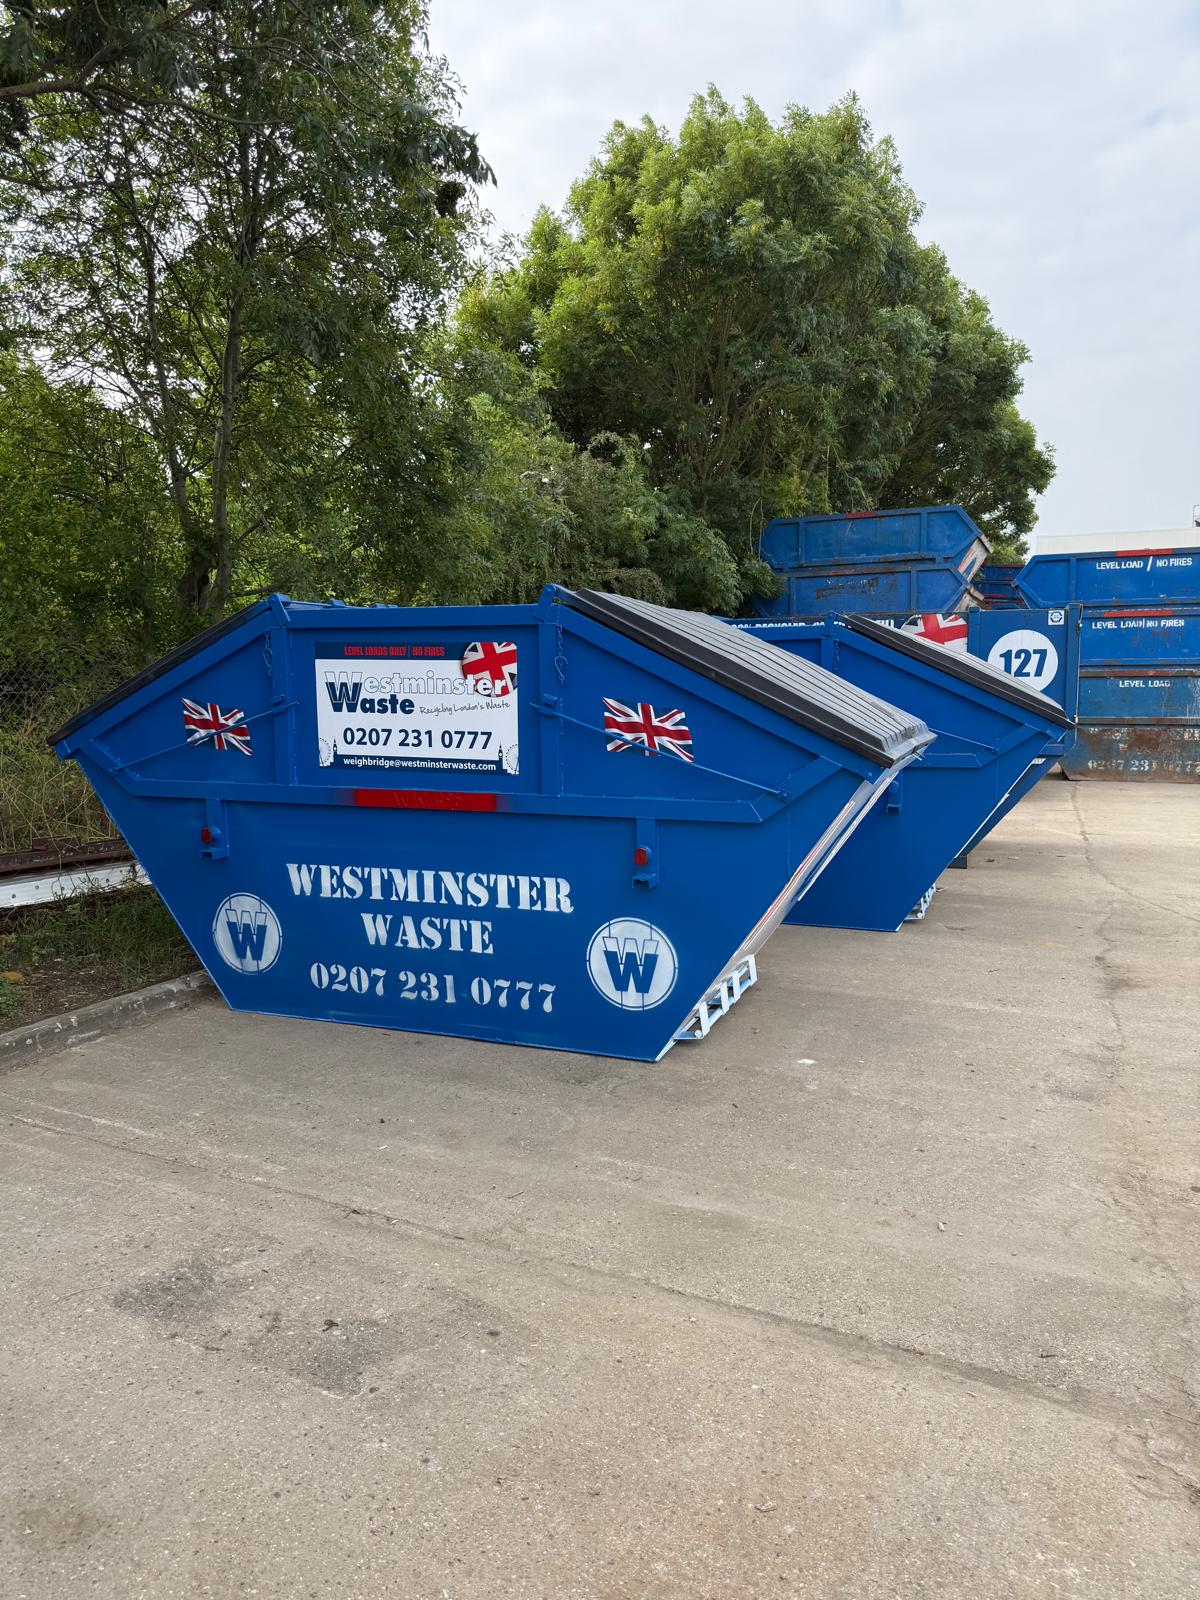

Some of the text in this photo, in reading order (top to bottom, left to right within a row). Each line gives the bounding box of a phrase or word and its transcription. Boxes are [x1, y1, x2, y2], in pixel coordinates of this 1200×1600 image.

[1096, 561, 1120, 570] LEVEL
[1121, 560, 1143, 569] LOAD
[1156, 559, 1168, 567] NO
[1169, 558, 1192, 566] FIRES
[1092, 620, 1117, 629] LEVEL
[1160, 619, 1185, 628] FIRES
[344, 646, 363, 656] LEVEL
[364, 646, 388, 656] LOADS
[389, 646, 407, 656] ONLY
[412, 647, 423, 656] NO
[423, 647, 445, 656] FIRES
[1000, 648, 1048, 678] 127
[324, 670, 507, 703] Westminster
[1119, 680, 1171, 688] LEVEL LOAD
[325, 682, 511, 716] Waste Recycling London's Waste
[343, 727, 493, 750] 0207 231 0777
[343, 757, 497, 771] weighbridge@westminsterwaste.com
[286, 863, 574, 914] WESTMINSTER
[360, 912, 493, 955] WASTE
[309, 962, 557, 1013] 0207 231 0777
